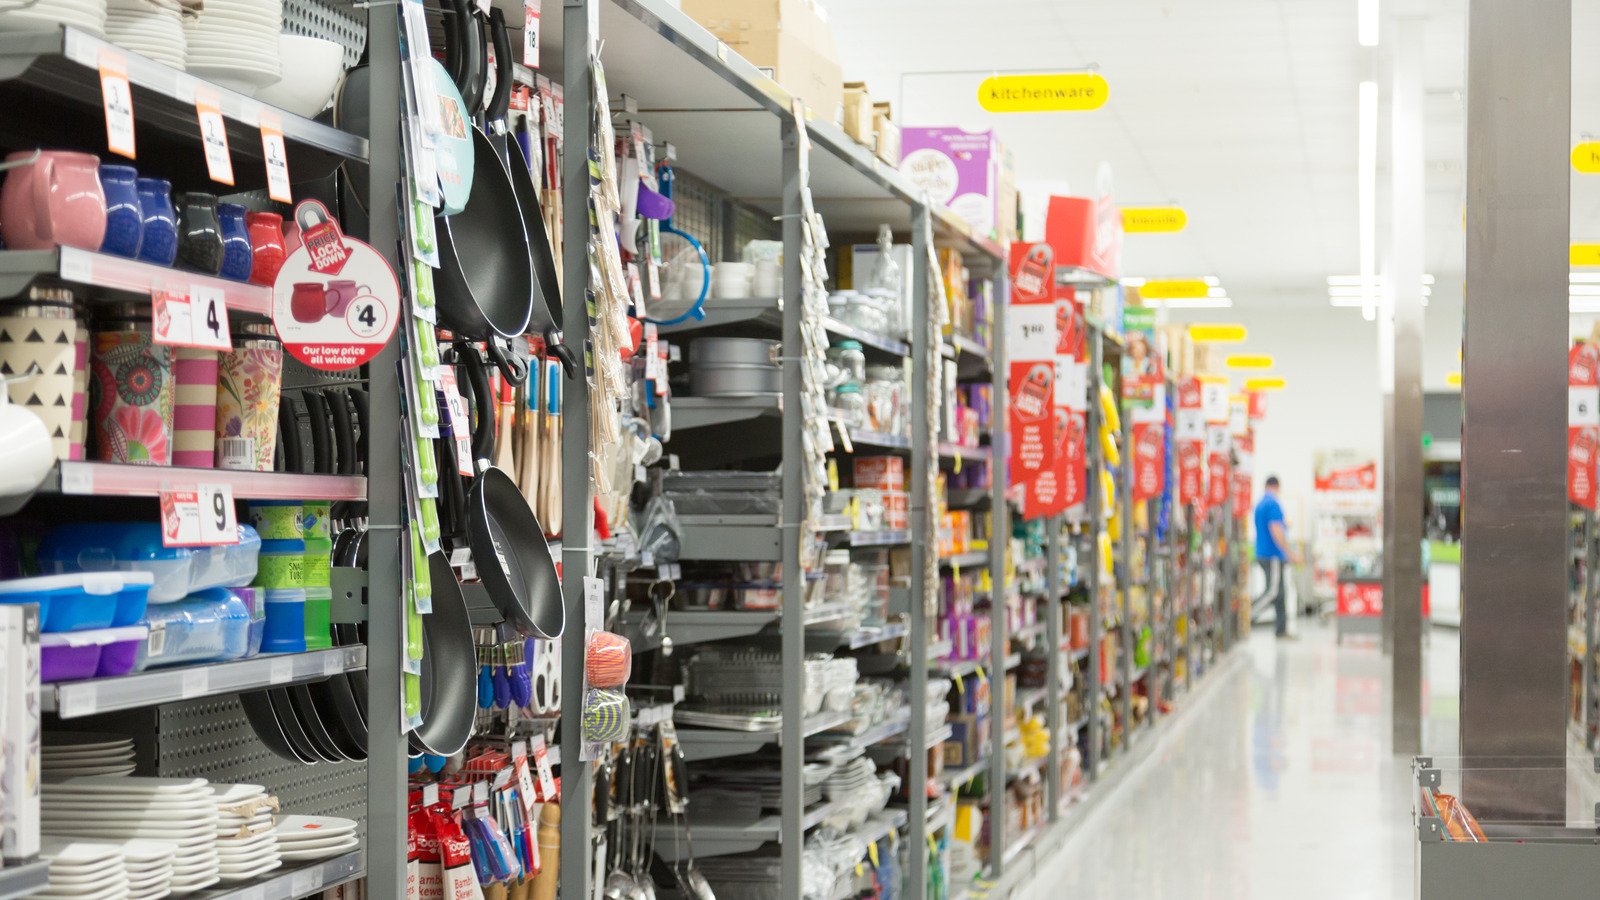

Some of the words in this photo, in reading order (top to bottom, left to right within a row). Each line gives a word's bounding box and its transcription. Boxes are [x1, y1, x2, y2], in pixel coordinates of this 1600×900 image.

[528, 31, 536, 48] 18
[991, 87, 1094, 100] kitchenware
[307, 231, 337, 250] PRICE
[311, 240, 342, 261] LOCK
[315, 250, 346, 270] DOWN
[207, 299, 219, 338] 4
[302, 346, 320, 355] Our
[321, 346, 340, 355] low
[341, 346, 365, 356] price
[310, 356, 323, 364] all
[325, 356, 356, 364] winter
[450, 399, 461, 417] 12
[213, 493, 226, 531] 9
